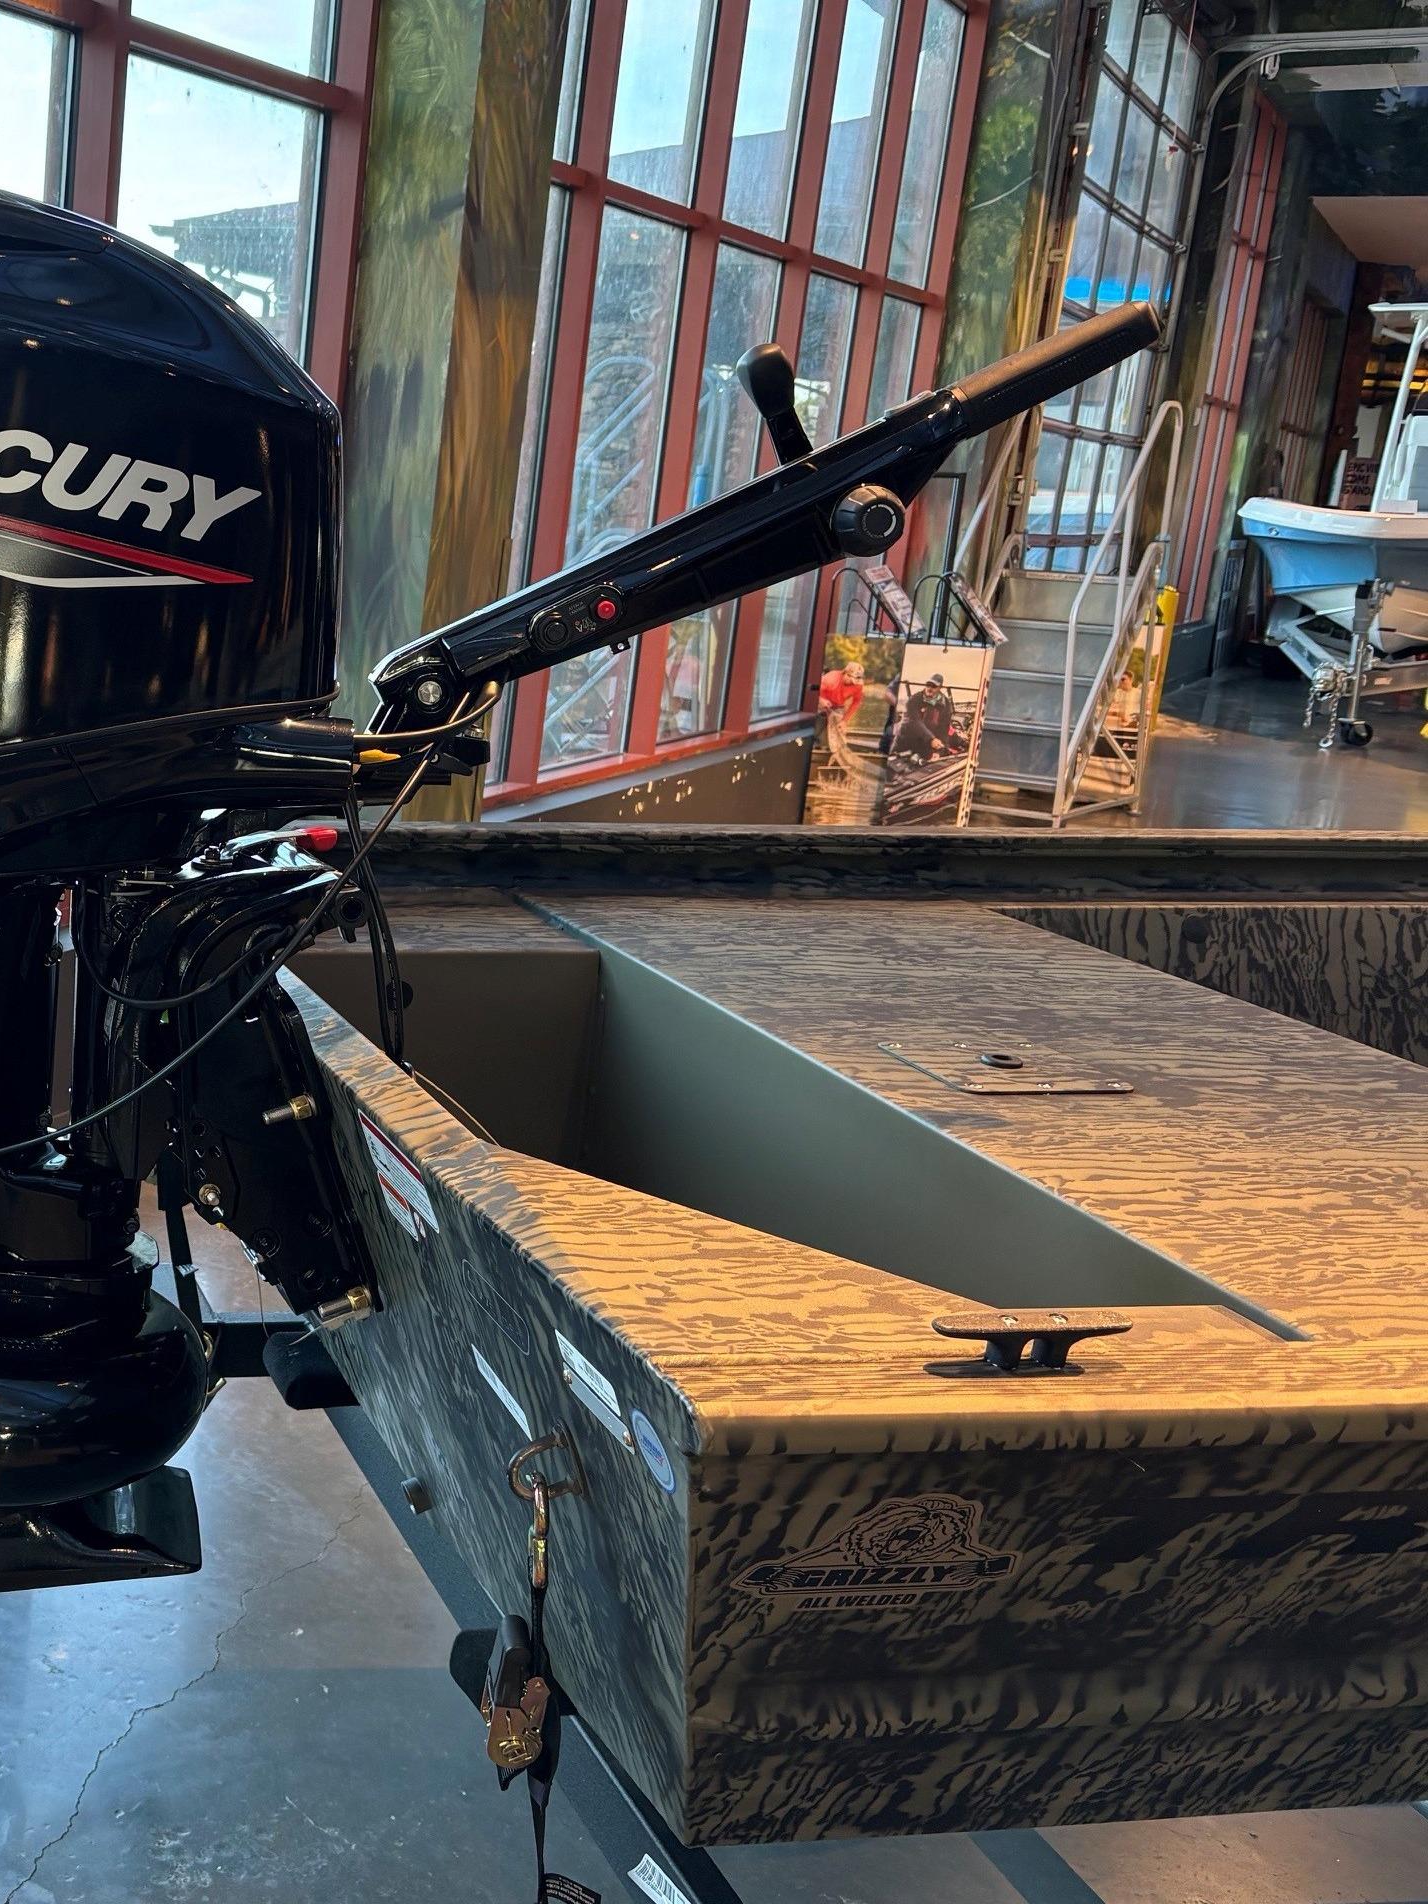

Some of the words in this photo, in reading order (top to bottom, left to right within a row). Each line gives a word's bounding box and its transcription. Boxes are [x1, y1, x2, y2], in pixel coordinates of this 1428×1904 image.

[793, 1566, 958, 1587] GRIZZLY
[798, 1597, 832, 1609] ALL
[836, 1594, 917, 1608] WELDED
